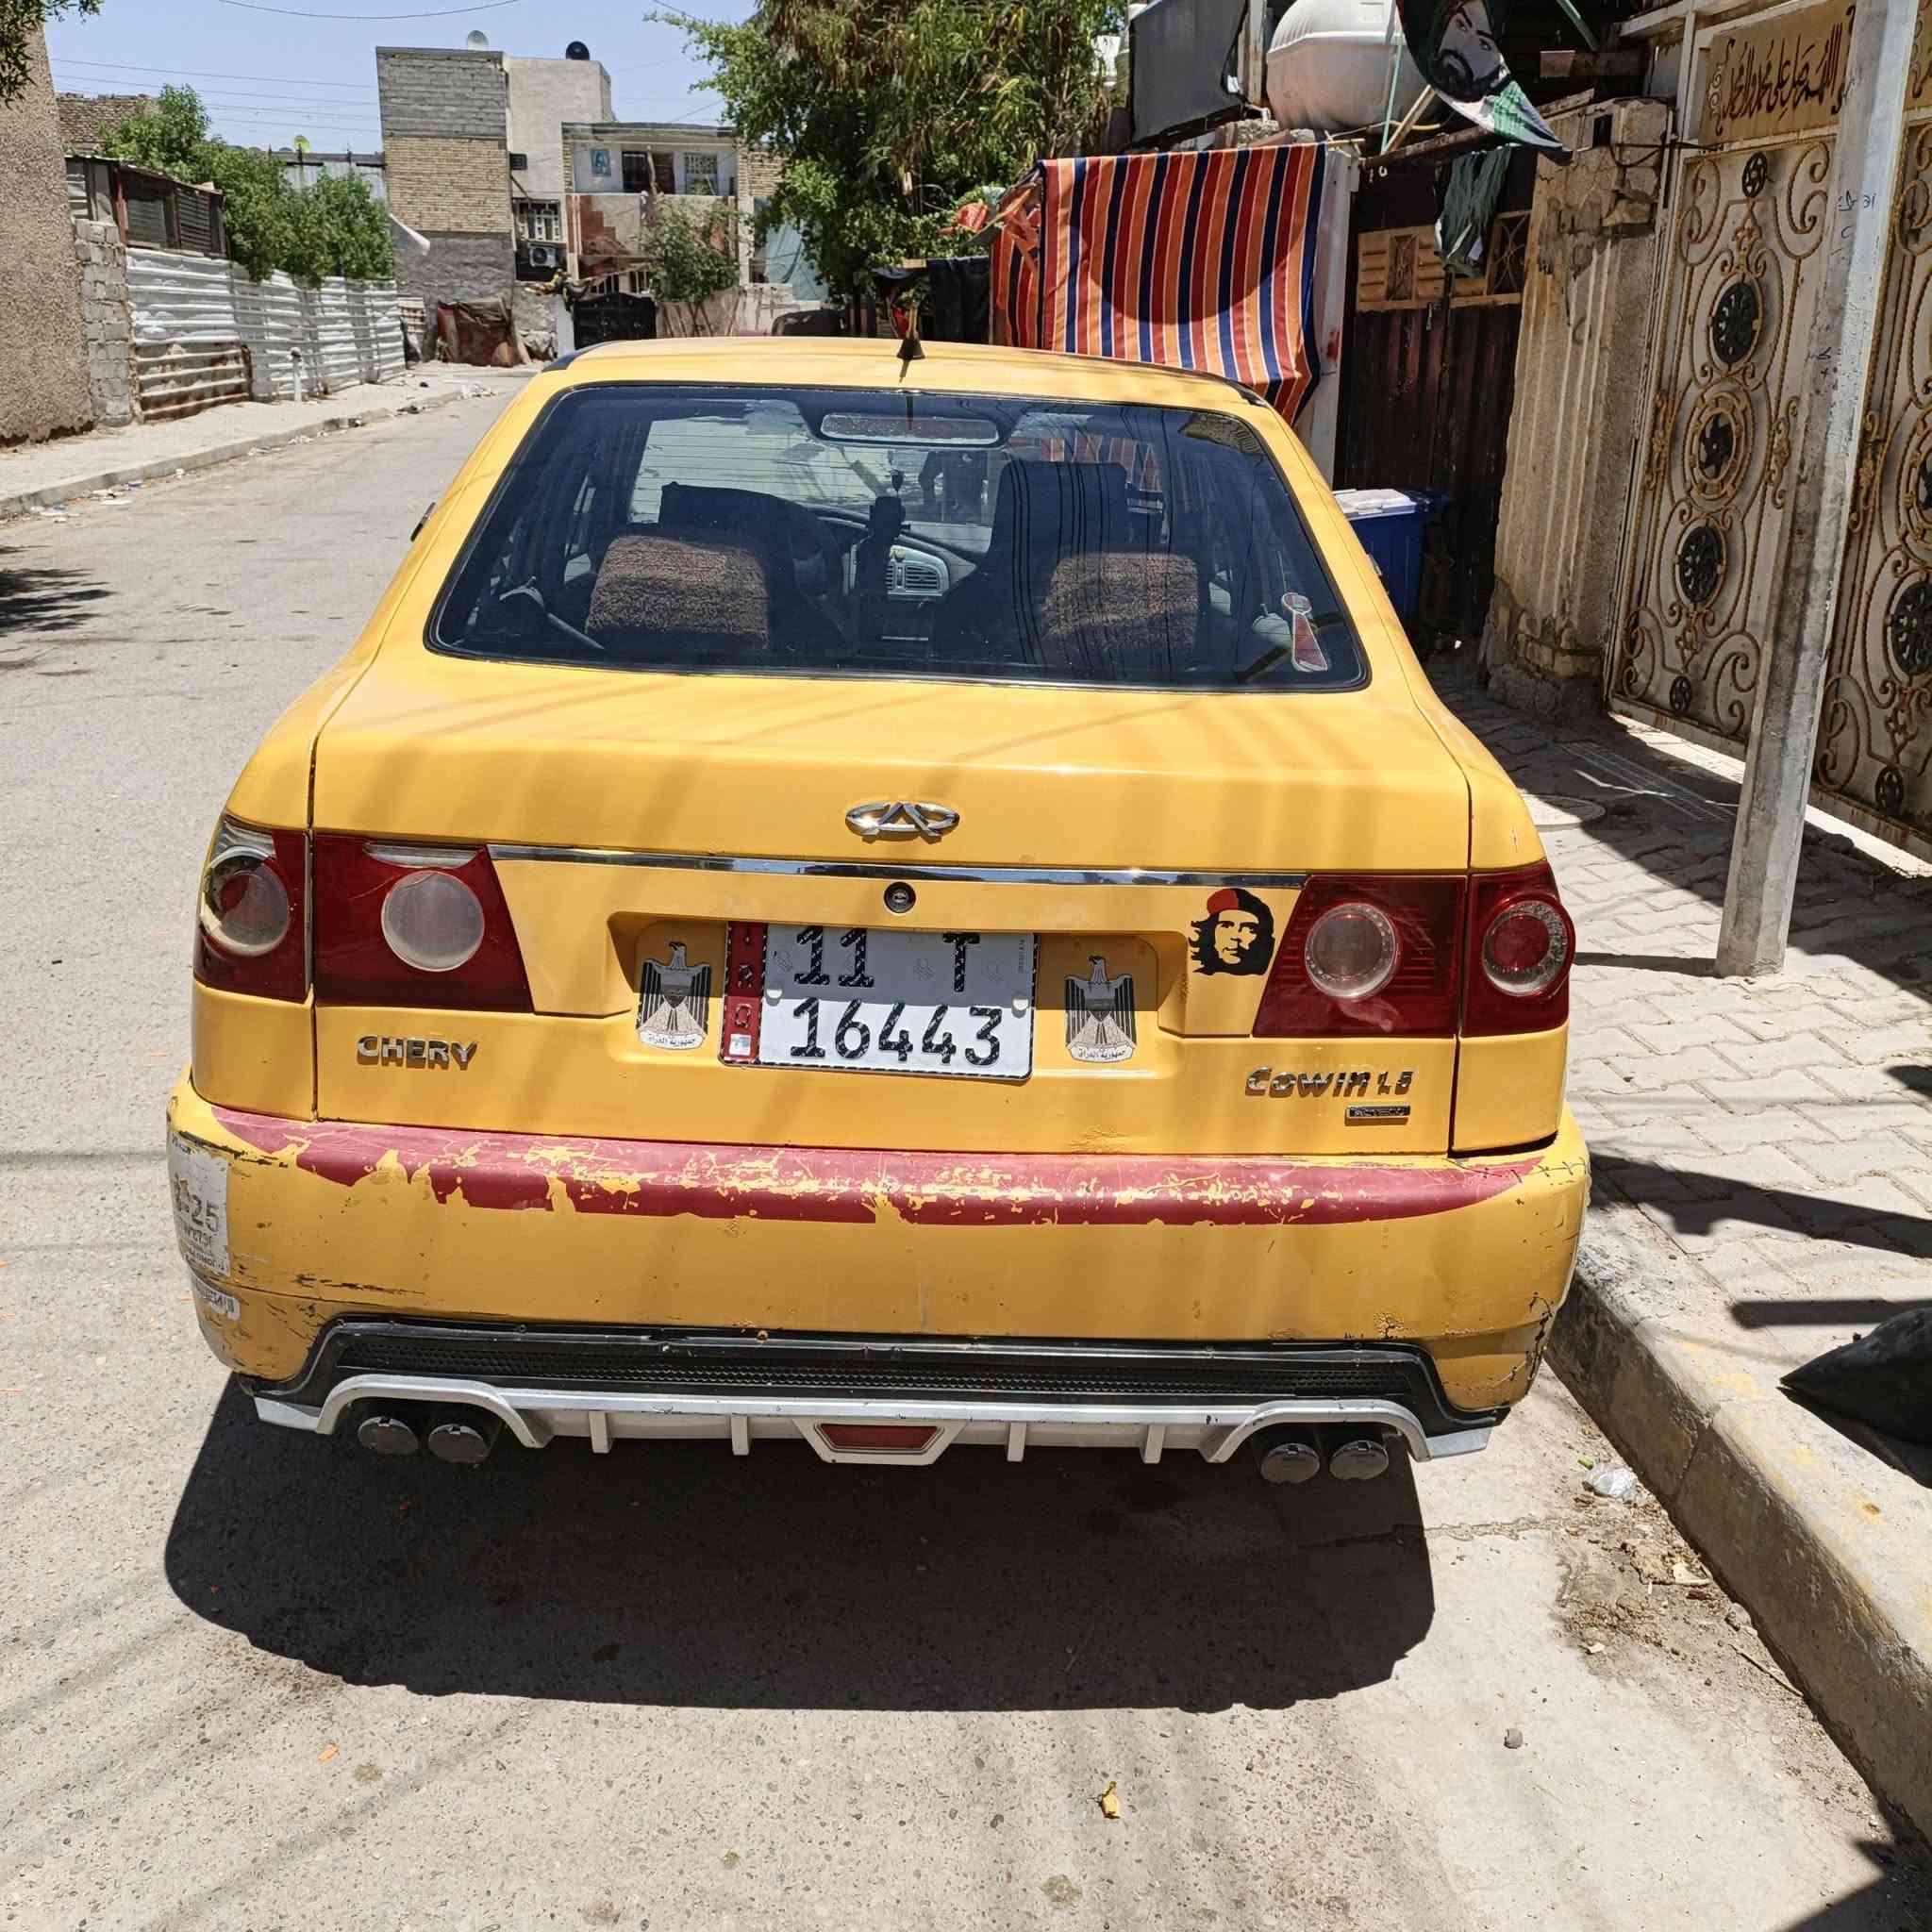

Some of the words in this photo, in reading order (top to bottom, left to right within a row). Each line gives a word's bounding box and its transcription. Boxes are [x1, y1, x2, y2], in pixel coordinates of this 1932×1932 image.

[793, 925, 875, 989] 11
[943, 932, 980, 993] T
[357, 1035, 478, 1069] CHERY
[790, 996, 1004, 1067] 16443
[1245, 1066, 1371, 1096] Cowin
